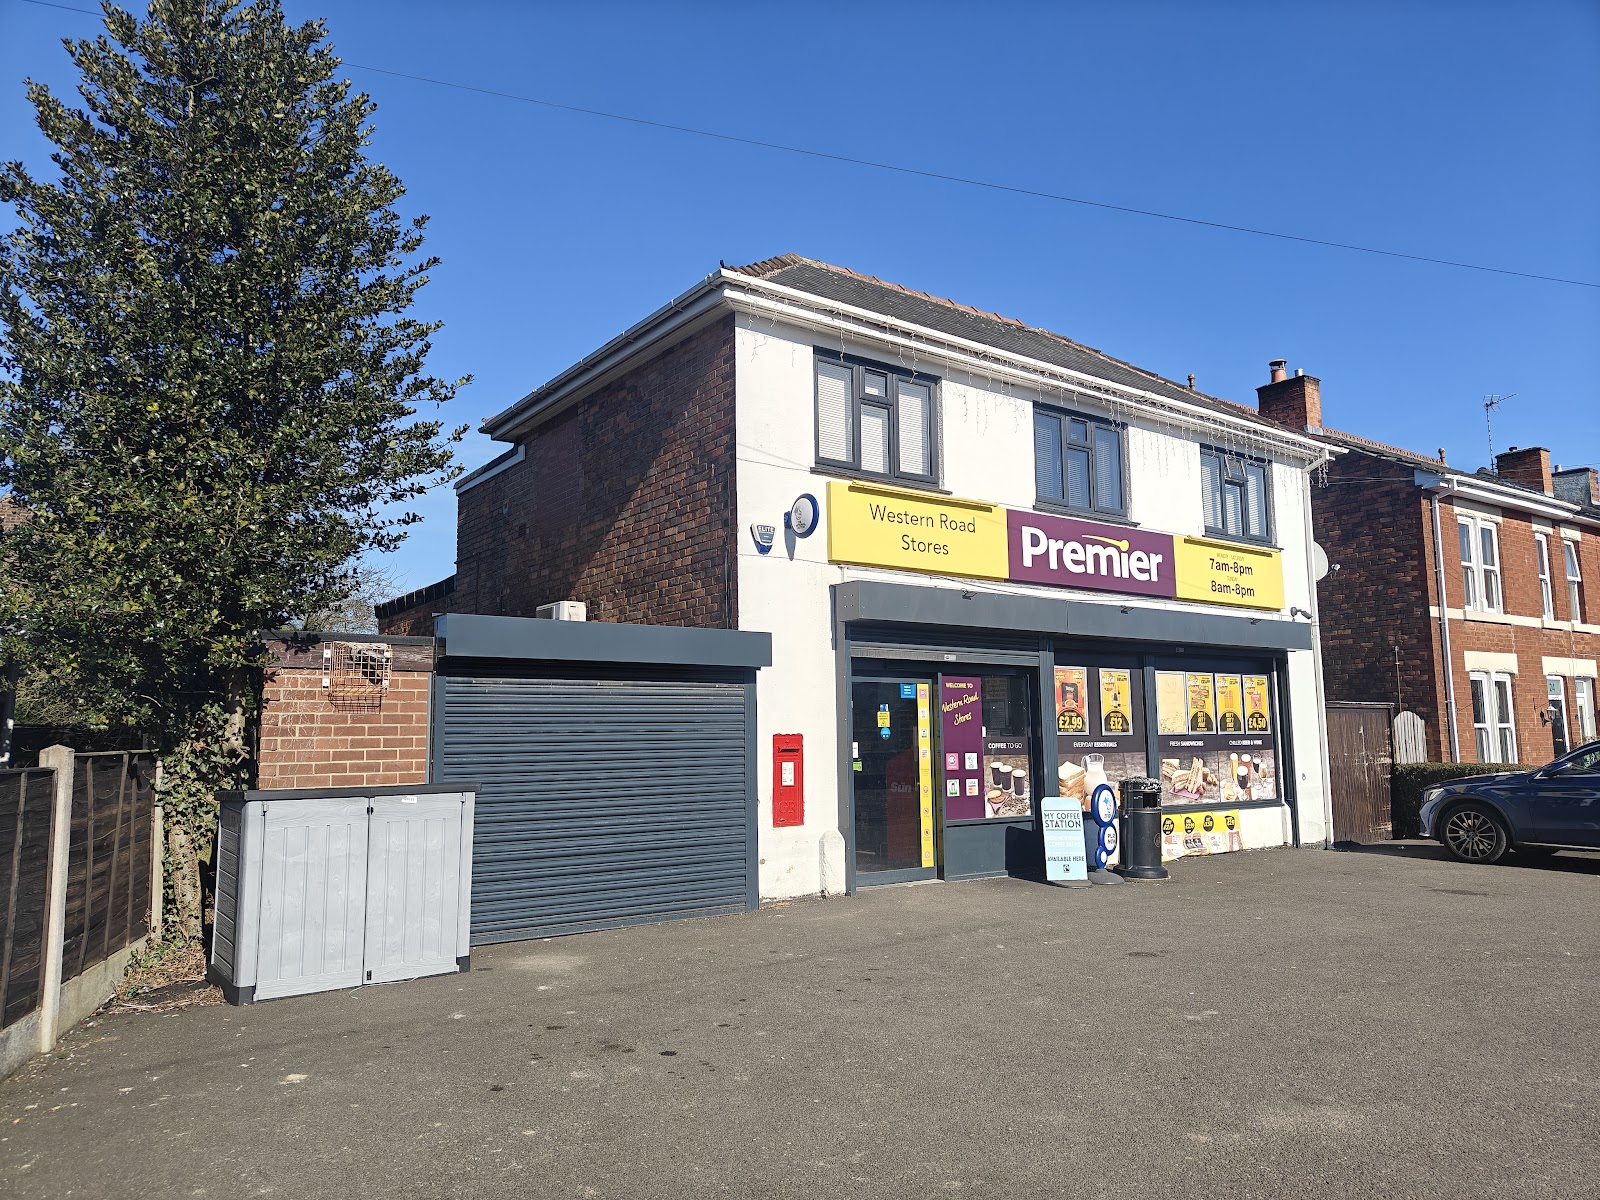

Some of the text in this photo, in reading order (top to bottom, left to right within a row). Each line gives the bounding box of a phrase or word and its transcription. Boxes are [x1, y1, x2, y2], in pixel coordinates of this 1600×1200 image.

[869, 503, 976, 534] Western Road
[757, 525, 775, 533] ELITE
[901, 534, 949, 555] Stores
[1021, 526, 1163, 582] Premier
[1209, 558, 1253, 576] 7am-8pm
[1211, 580, 1255, 598] 8am-8pm
[963, 692, 979, 706] Road
[953, 712, 972, 726] Stores
[1059, 716, 1083, 729] £2.99
[1110, 717, 1123, 730] £12
[1248, 717, 1266, 729] £4.50
[890, 782, 912, 793] Sun
[1043, 812, 1081, 820] MY COFFEE
[1044, 819, 1081, 828] STATION
